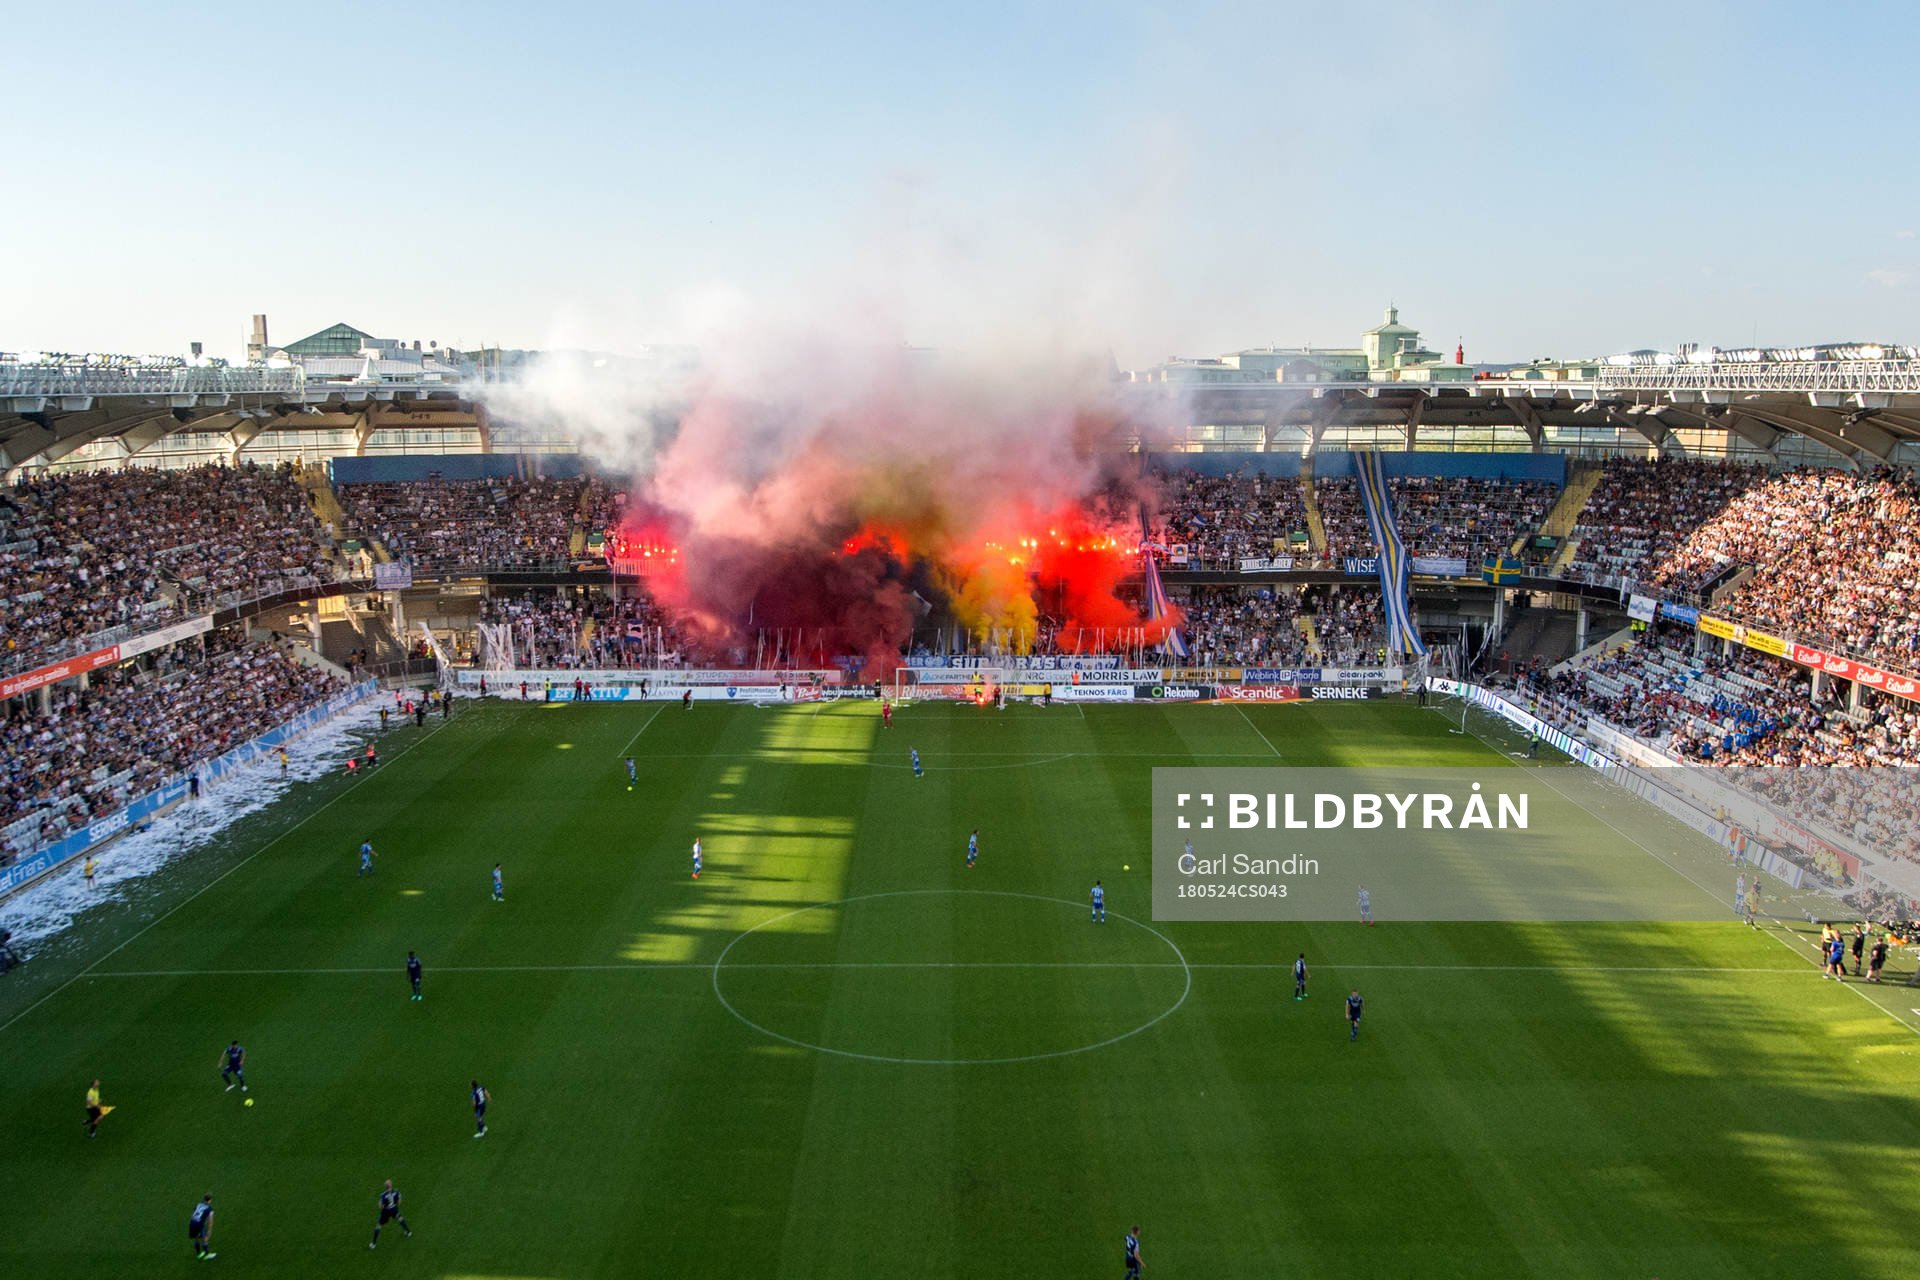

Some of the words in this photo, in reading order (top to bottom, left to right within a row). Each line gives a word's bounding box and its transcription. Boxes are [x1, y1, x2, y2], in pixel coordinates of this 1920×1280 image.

[1025, 671, 1044, 681] NRC
[1082, 671, 1129, 681] MORRIS
[1133, 671, 1159, 681] LAW
[1246, 671, 1279, 680] Weblink
[1856, 668, 1883, 683] Estrella
[1886, 677, 1915, 694] Estrella
[1164, 686, 1200, 698] Rekomo
[1232, 686, 1284, 698] Scandic
[1311, 687, 1368, 699] SERNEKE
